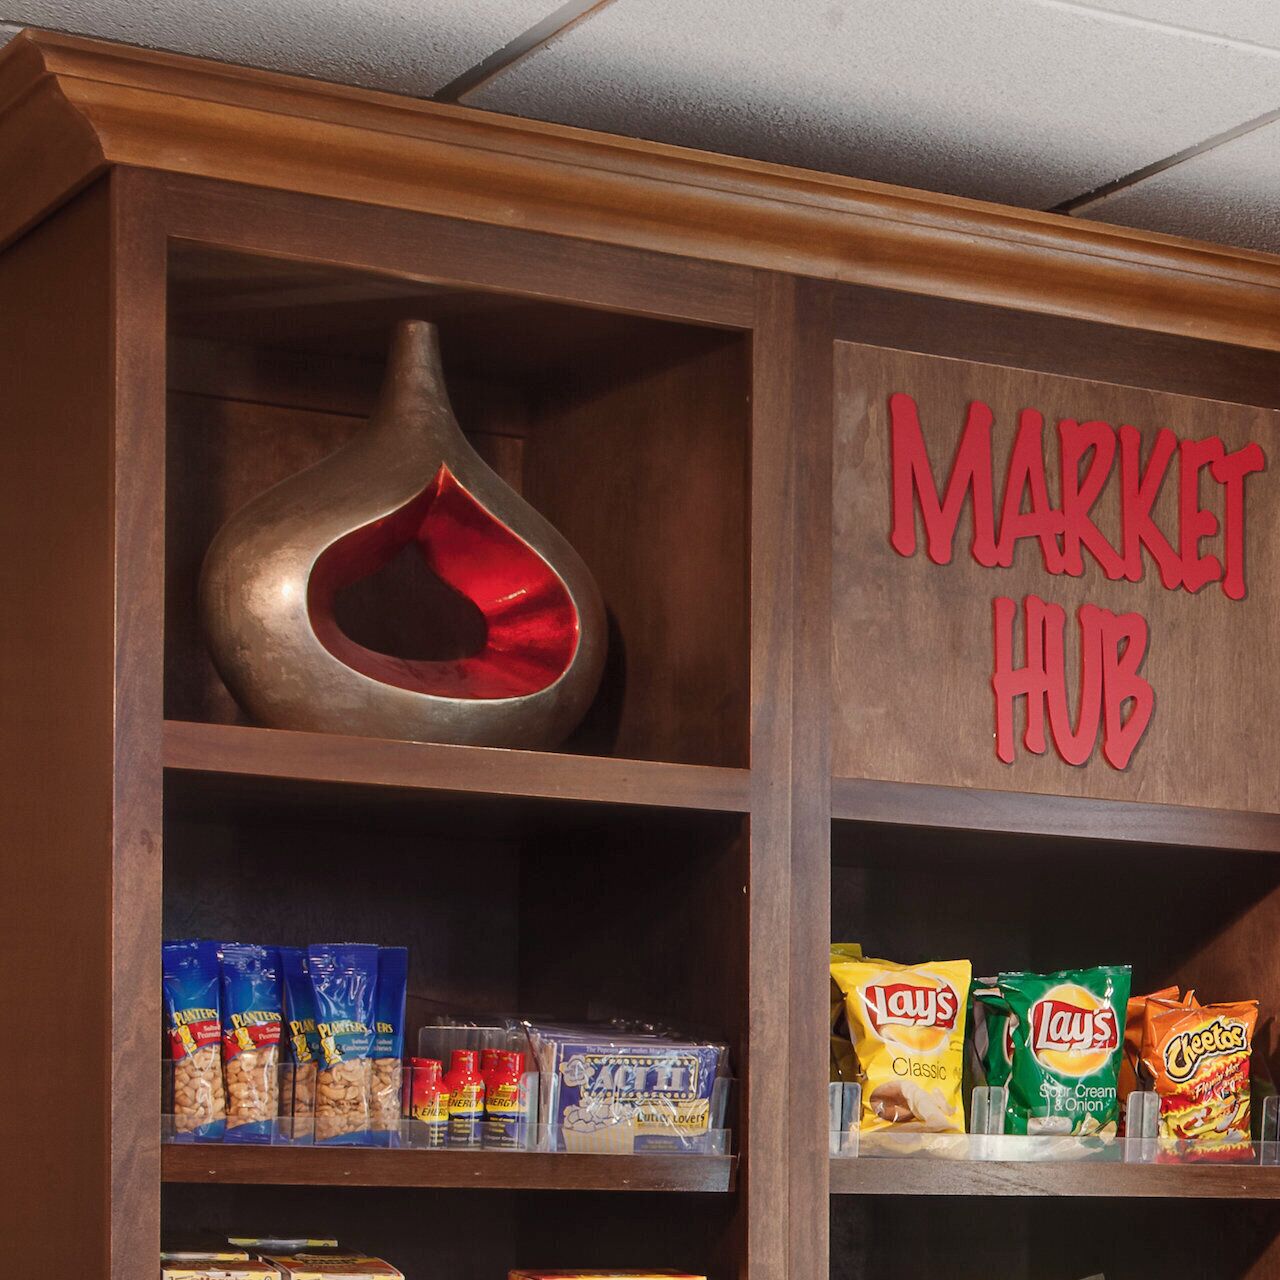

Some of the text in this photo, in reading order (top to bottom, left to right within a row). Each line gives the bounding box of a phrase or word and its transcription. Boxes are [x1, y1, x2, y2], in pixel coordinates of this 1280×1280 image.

[889, 392, 1265, 600] MARKET
[992, 595, 1155, 769] HUB
[173, 1009, 217, 1027] PLANTERS
[875, 984, 958, 1030] Lay's
[231, 1011, 281, 1029] PLANTERS
[317, 1020, 368, 1038] PLANTERS
[1036, 1000, 1113, 1052] Lay's
[1166, 1021, 1244, 1079] Cheetos
[590, 1066, 645, 1093] ACT
[892, 1056, 948, 1081] Classic
[449, 1097, 480, 1108] ENERGY
[1039, 1083, 1117, 1099] Sour Cream
[1053, 1097, 1104, 1112] & Onion
